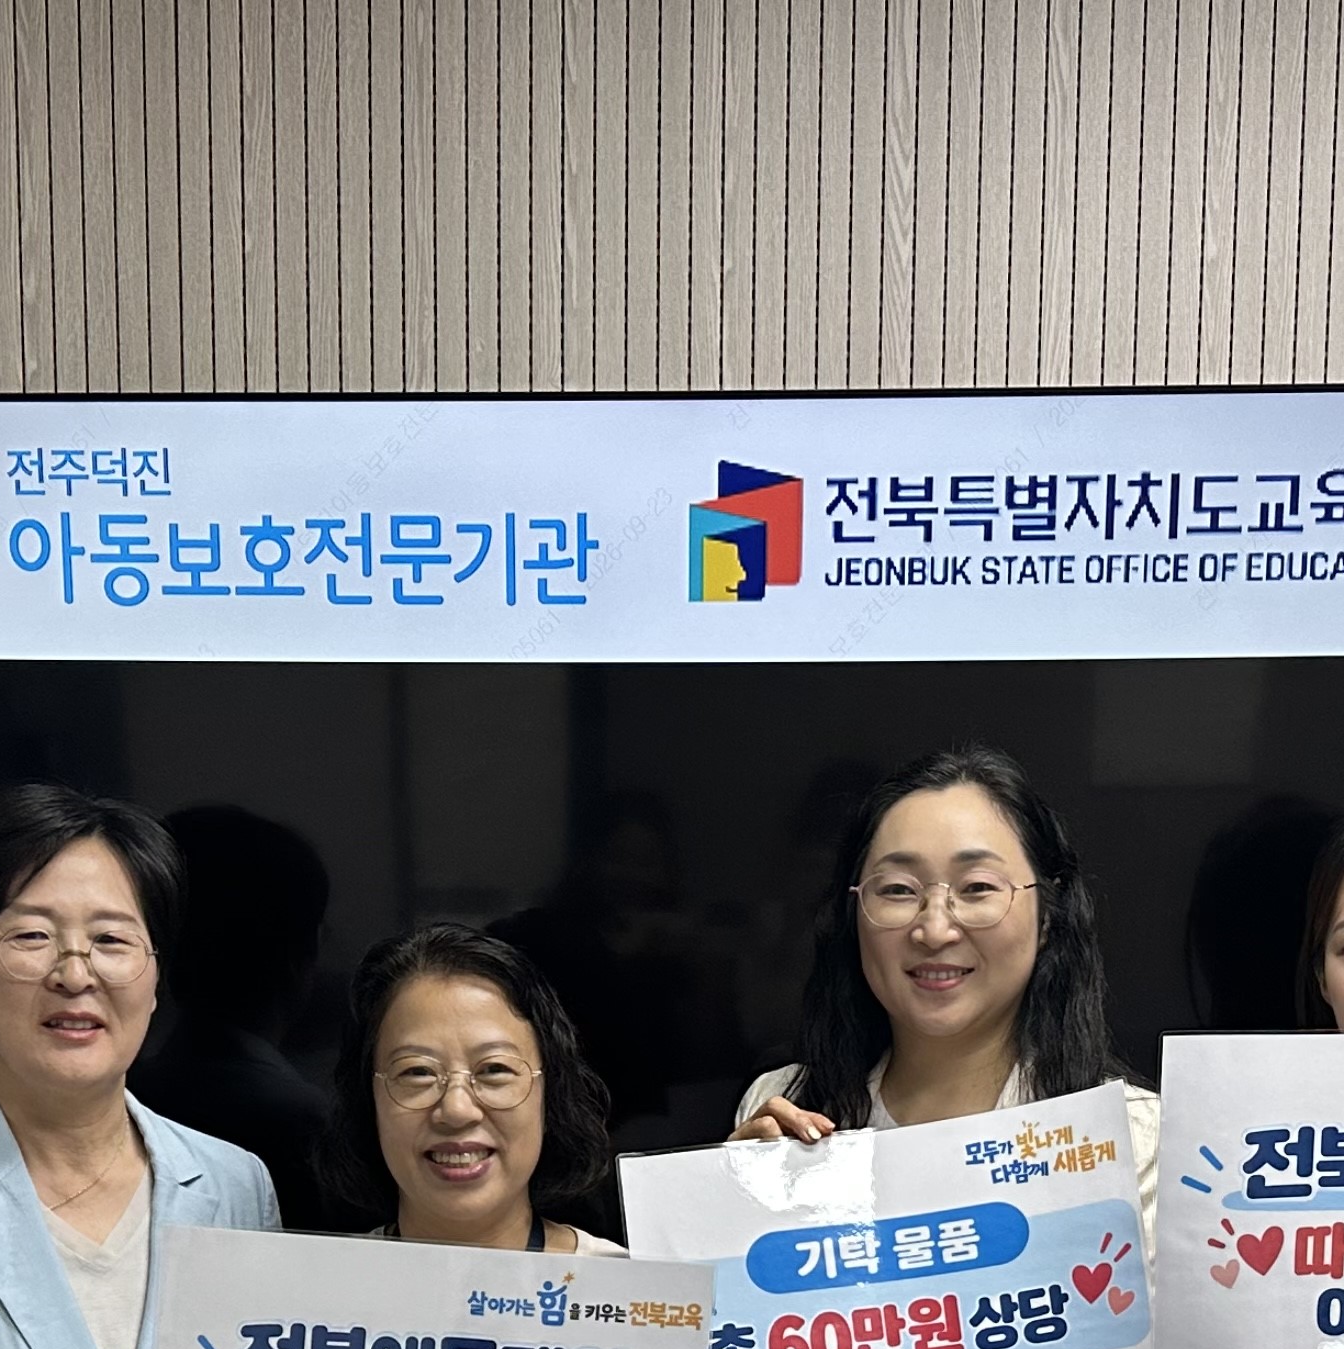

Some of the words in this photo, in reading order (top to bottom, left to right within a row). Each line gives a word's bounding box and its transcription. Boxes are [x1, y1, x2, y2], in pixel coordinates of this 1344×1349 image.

[6, 446, 173, 497] 전주덕진
[8, 512, 599, 607] 아동보호전문기관
[823, 554, 971, 587] JEONBUK
[981, 554, 1075, 585] STATE
[1085, 552, 1189, 584] OFFICE
[1199, 552, 1240, 583] OF
[964, 1140, 1014, 1166] 모두가
[1015, 1122, 1074, 1160] 빛나게
[990, 1158, 1049, 1184] 다함께
[1053, 1137, 1117, 1173] 새롭게
[795, 1230, 879, 1280] 기탁
[892, 1218, 981, 1272] 물품
[467, 1290, 536, 1317] 살아가는
[584, 1303, 627, 1324] 키우는
[628, 1300, 704, 1331] 전북교육
